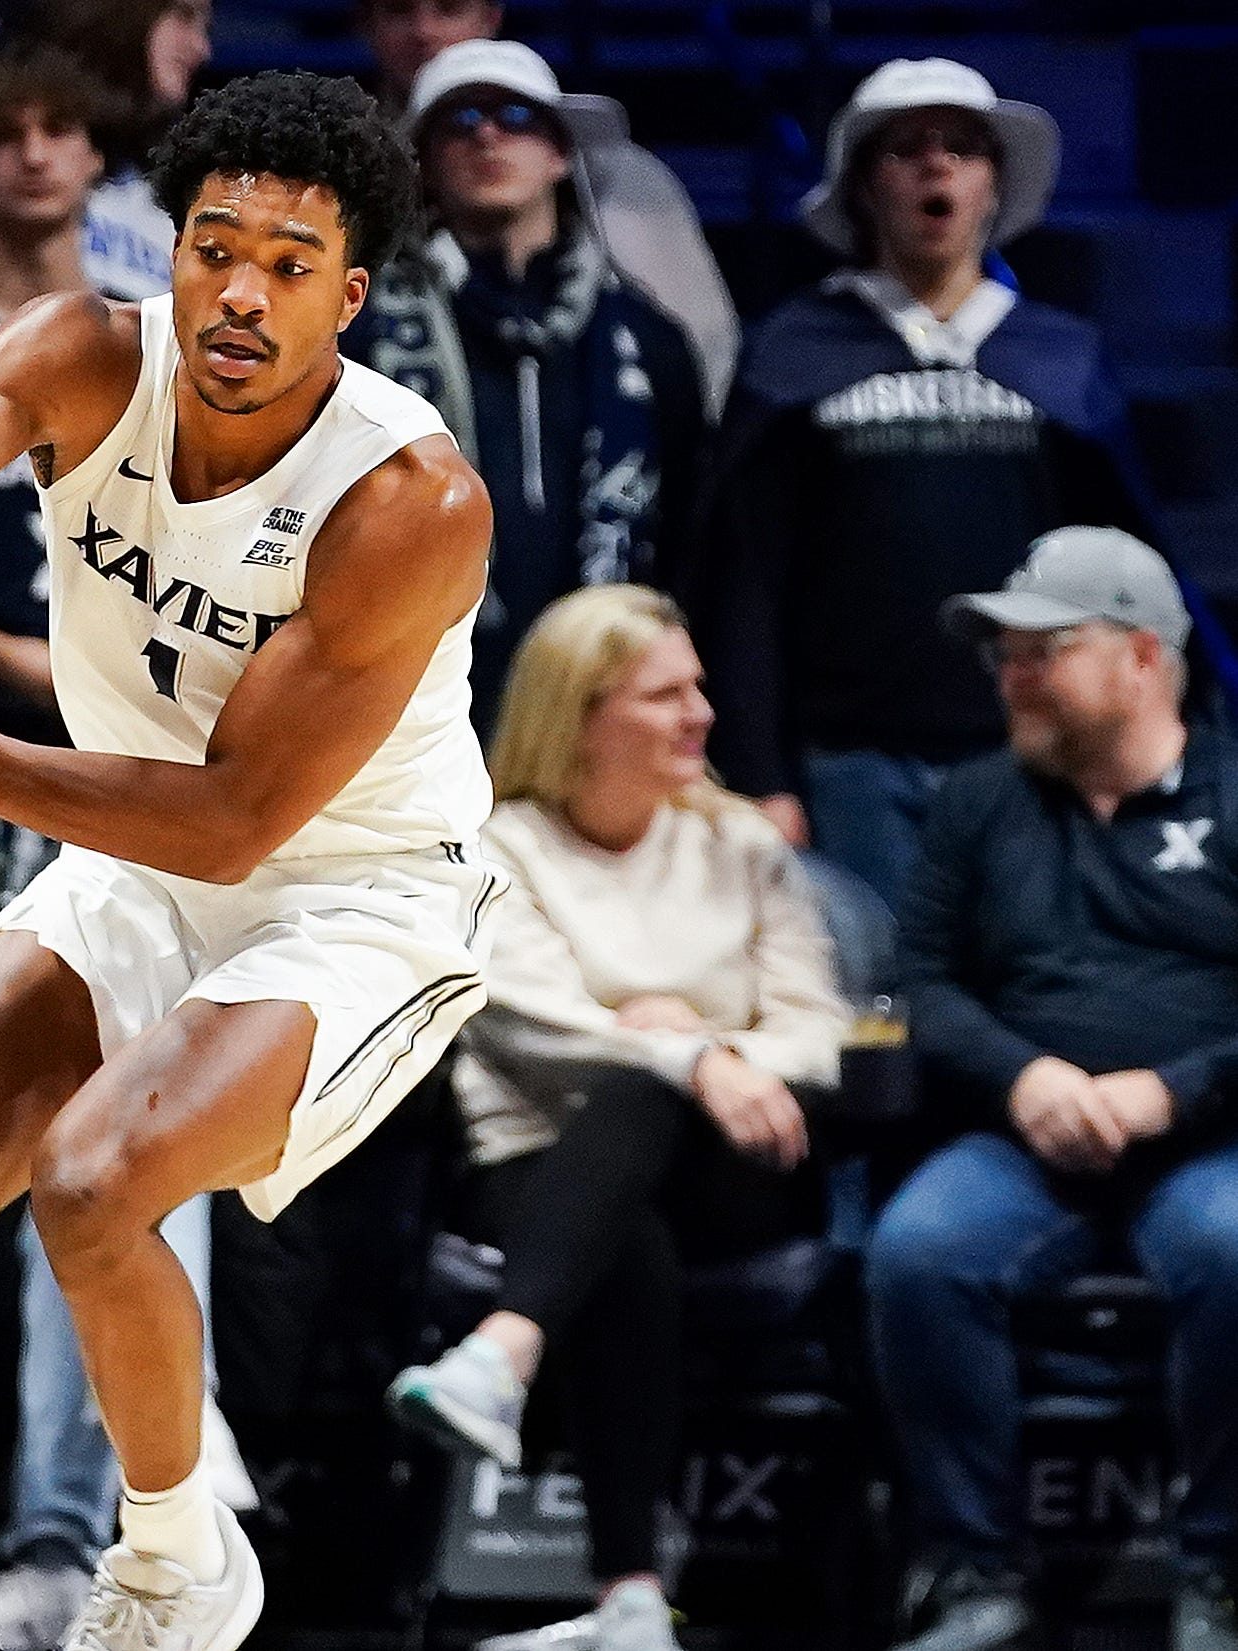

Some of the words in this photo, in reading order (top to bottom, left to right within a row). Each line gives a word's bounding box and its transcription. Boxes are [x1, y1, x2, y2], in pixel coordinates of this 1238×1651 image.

[284, 508, 307, 523] THE
[253, 539, 287, 553] BIG
[245, 549, 296, 565] EAST
[141, 636, 187, 705] 1
